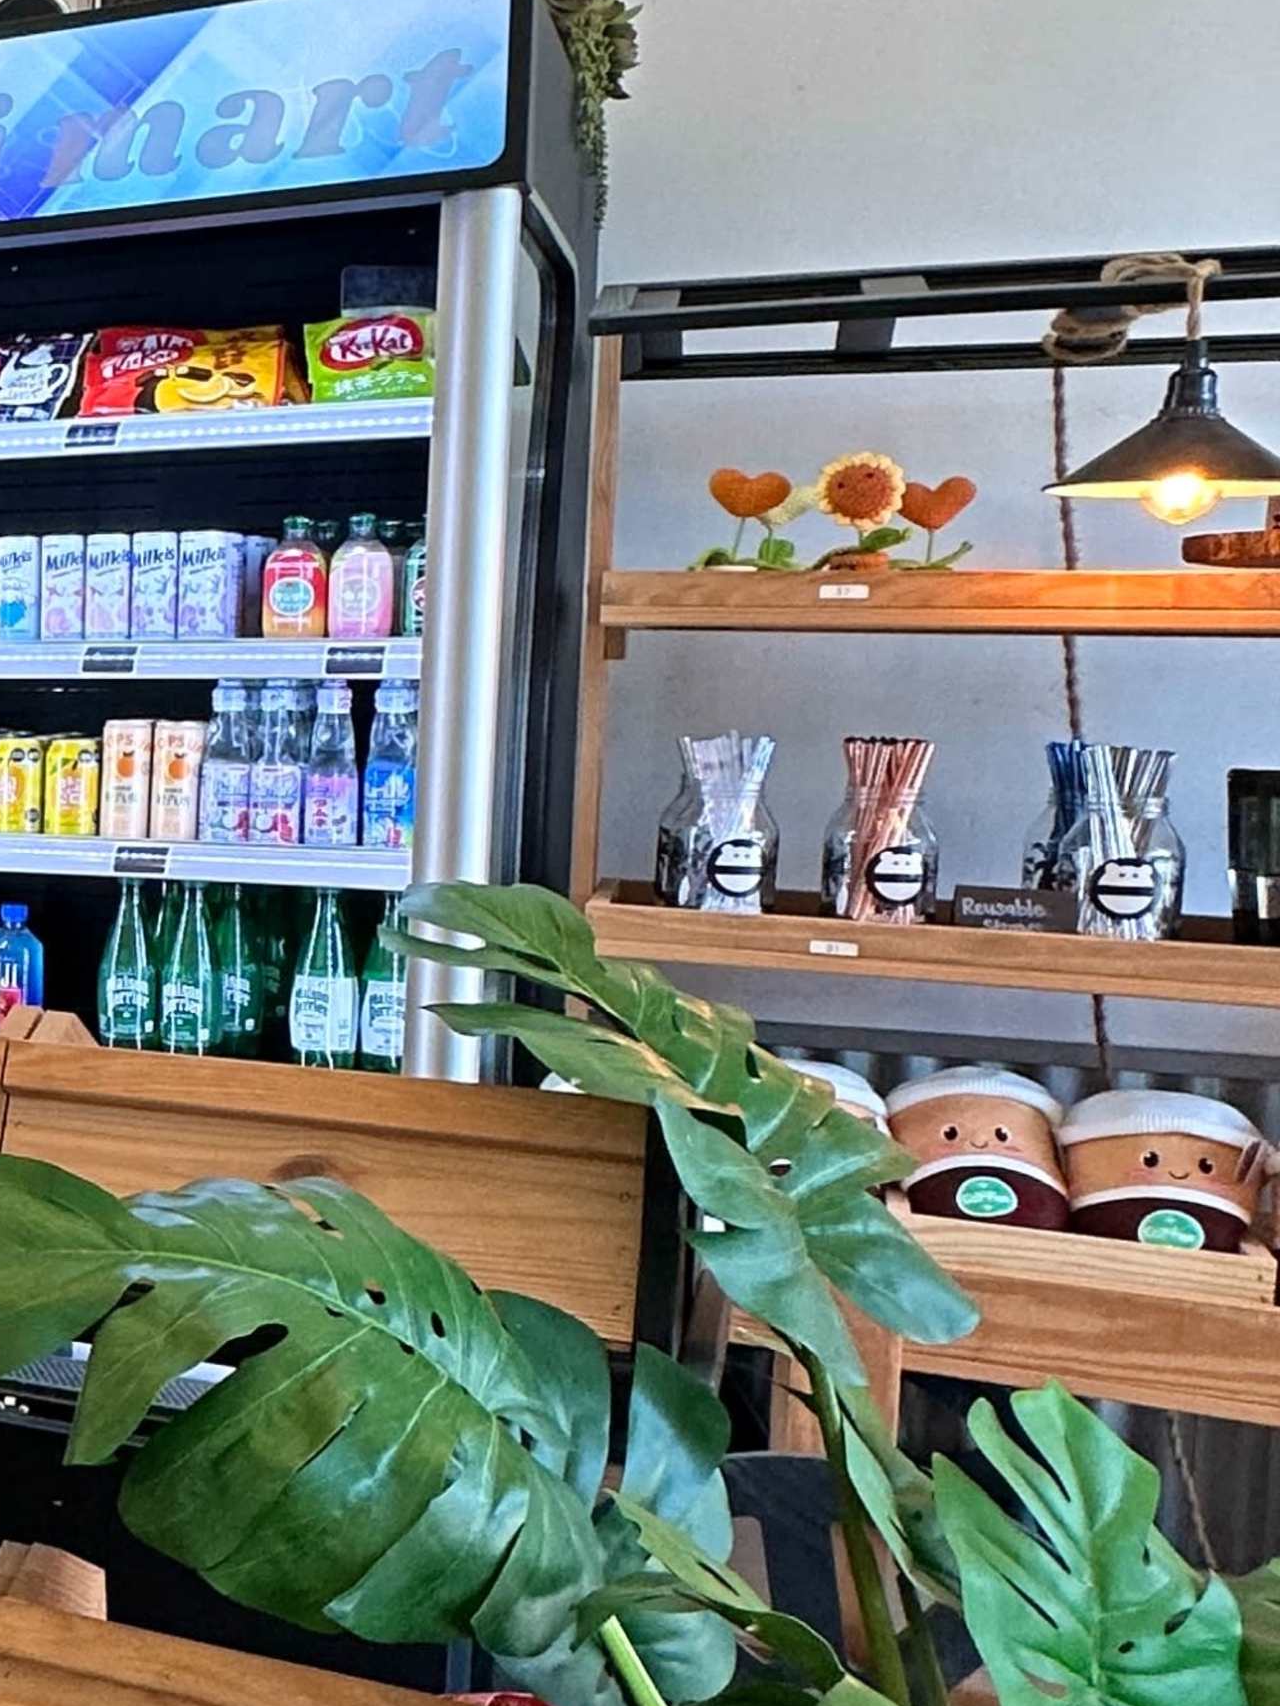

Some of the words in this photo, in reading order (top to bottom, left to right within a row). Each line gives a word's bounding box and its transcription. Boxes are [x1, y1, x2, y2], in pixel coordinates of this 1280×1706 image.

[41, 47, 473, 188] mart
[335, 326, 410, 360] KitKat
[961, 897, 1048, 918] Reusable
